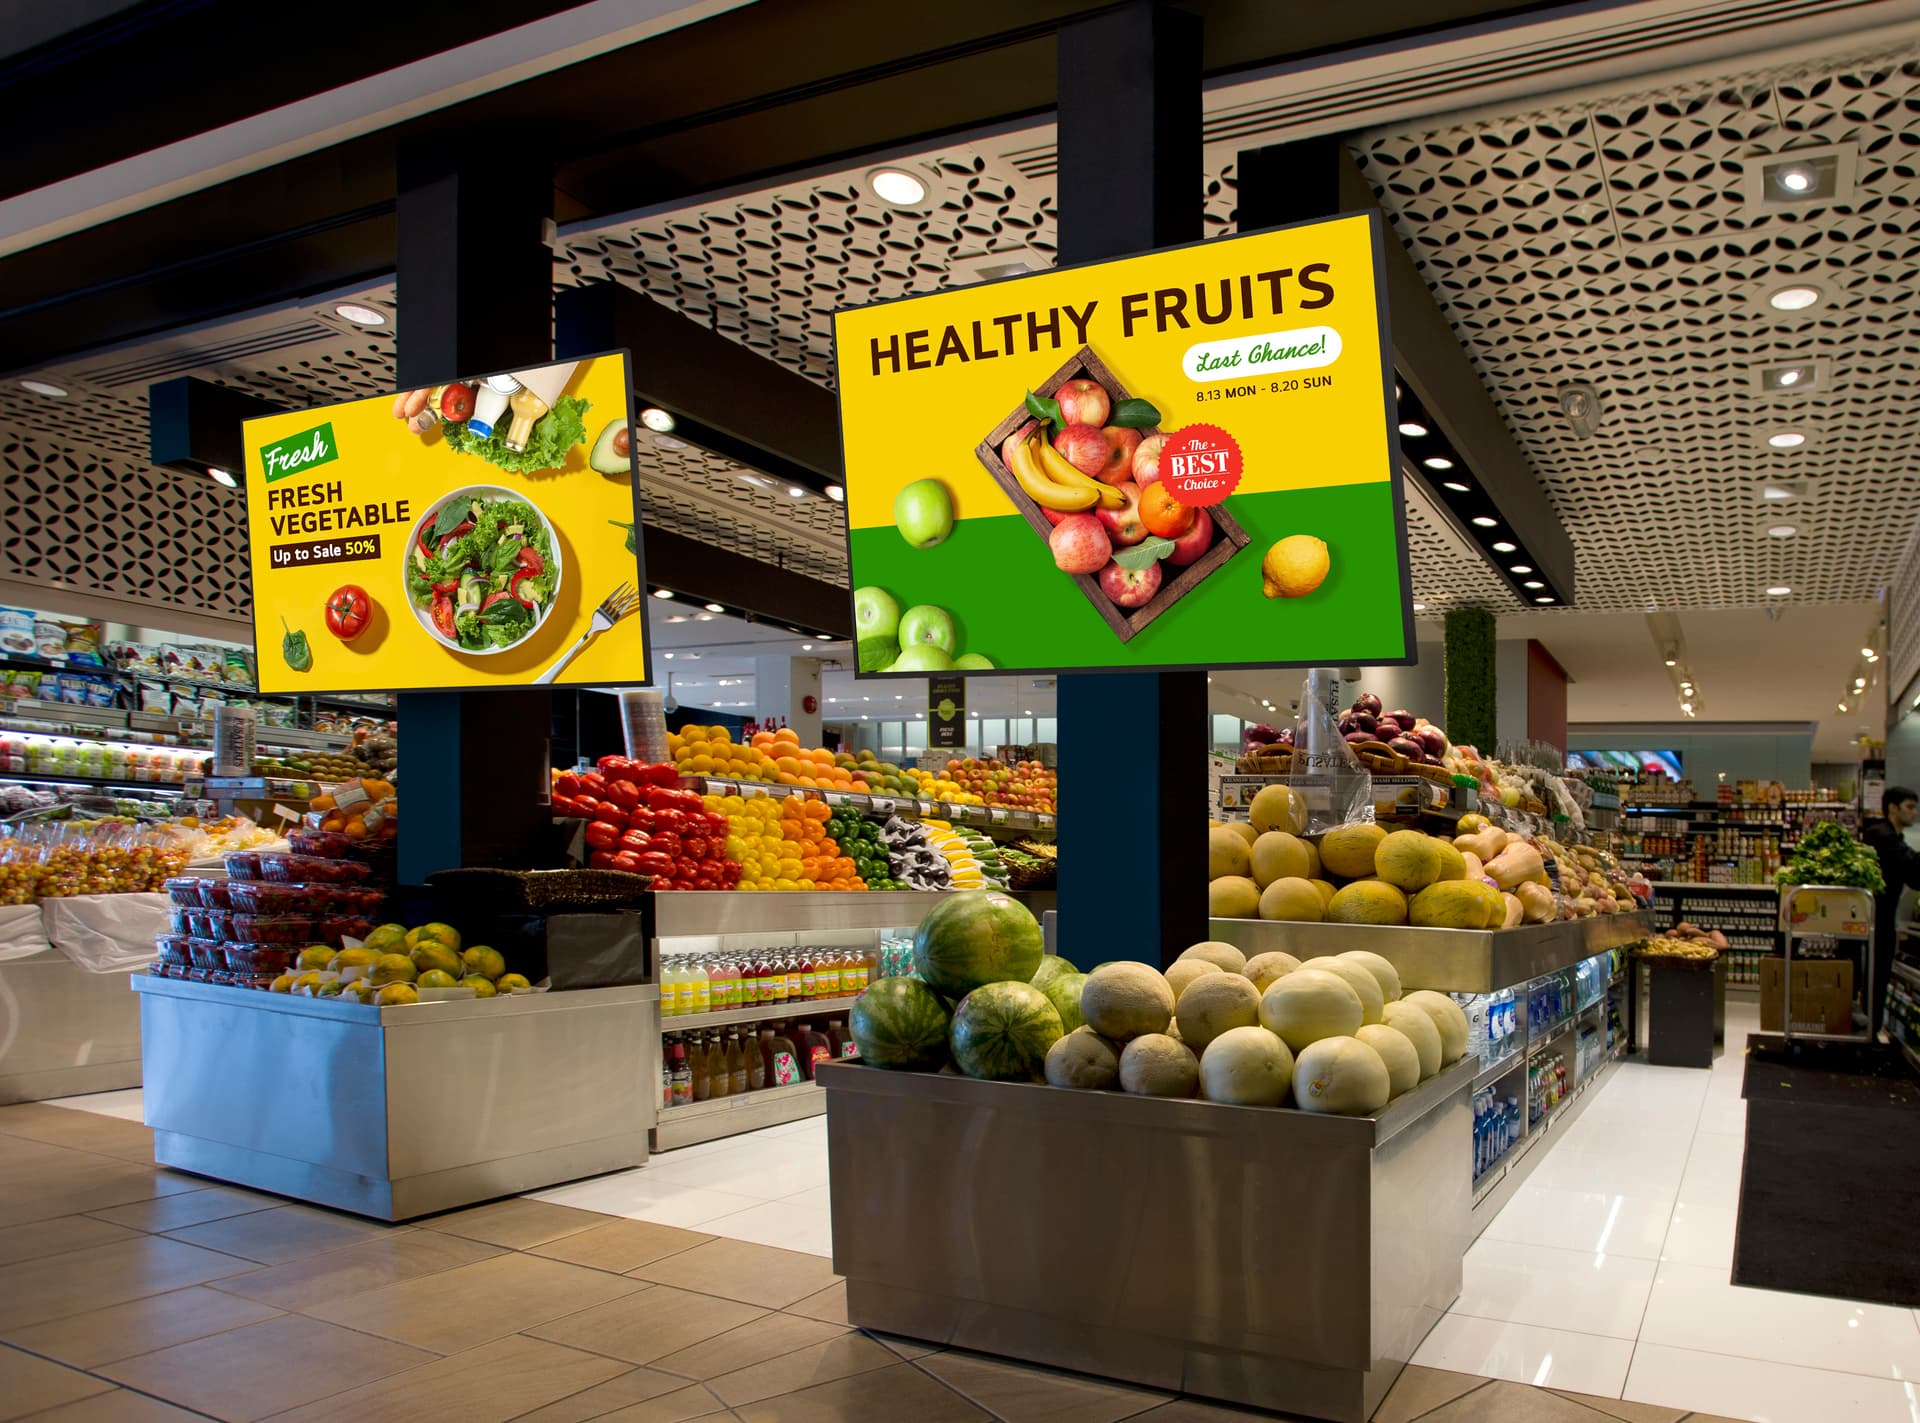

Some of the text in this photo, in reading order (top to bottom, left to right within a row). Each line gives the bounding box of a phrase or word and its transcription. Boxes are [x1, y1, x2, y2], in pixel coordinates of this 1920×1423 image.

[871, 263, 1335, 375] HEALTHY FRUITS
[1197, 348, 1242, 373] Last
[1196, 389, 1222, 402] 8.13
[1226, 385, 1257, 399] MON
[1270, 380, 1299, 393] 8.20
[1303, 375, 1332, 389] SUN
[264, 431, 328, 476] Fresh
[1188, 439, 1208, 451] The
[1170, 451, 1229, 477] BEST
[268, 481, 343, 511] FRESH
[1184, 478, 1219, 491] Choice
[270, 500, 411, 537] VEGETABLE
[273, 539, 376, 565] Up to Sale 50%
